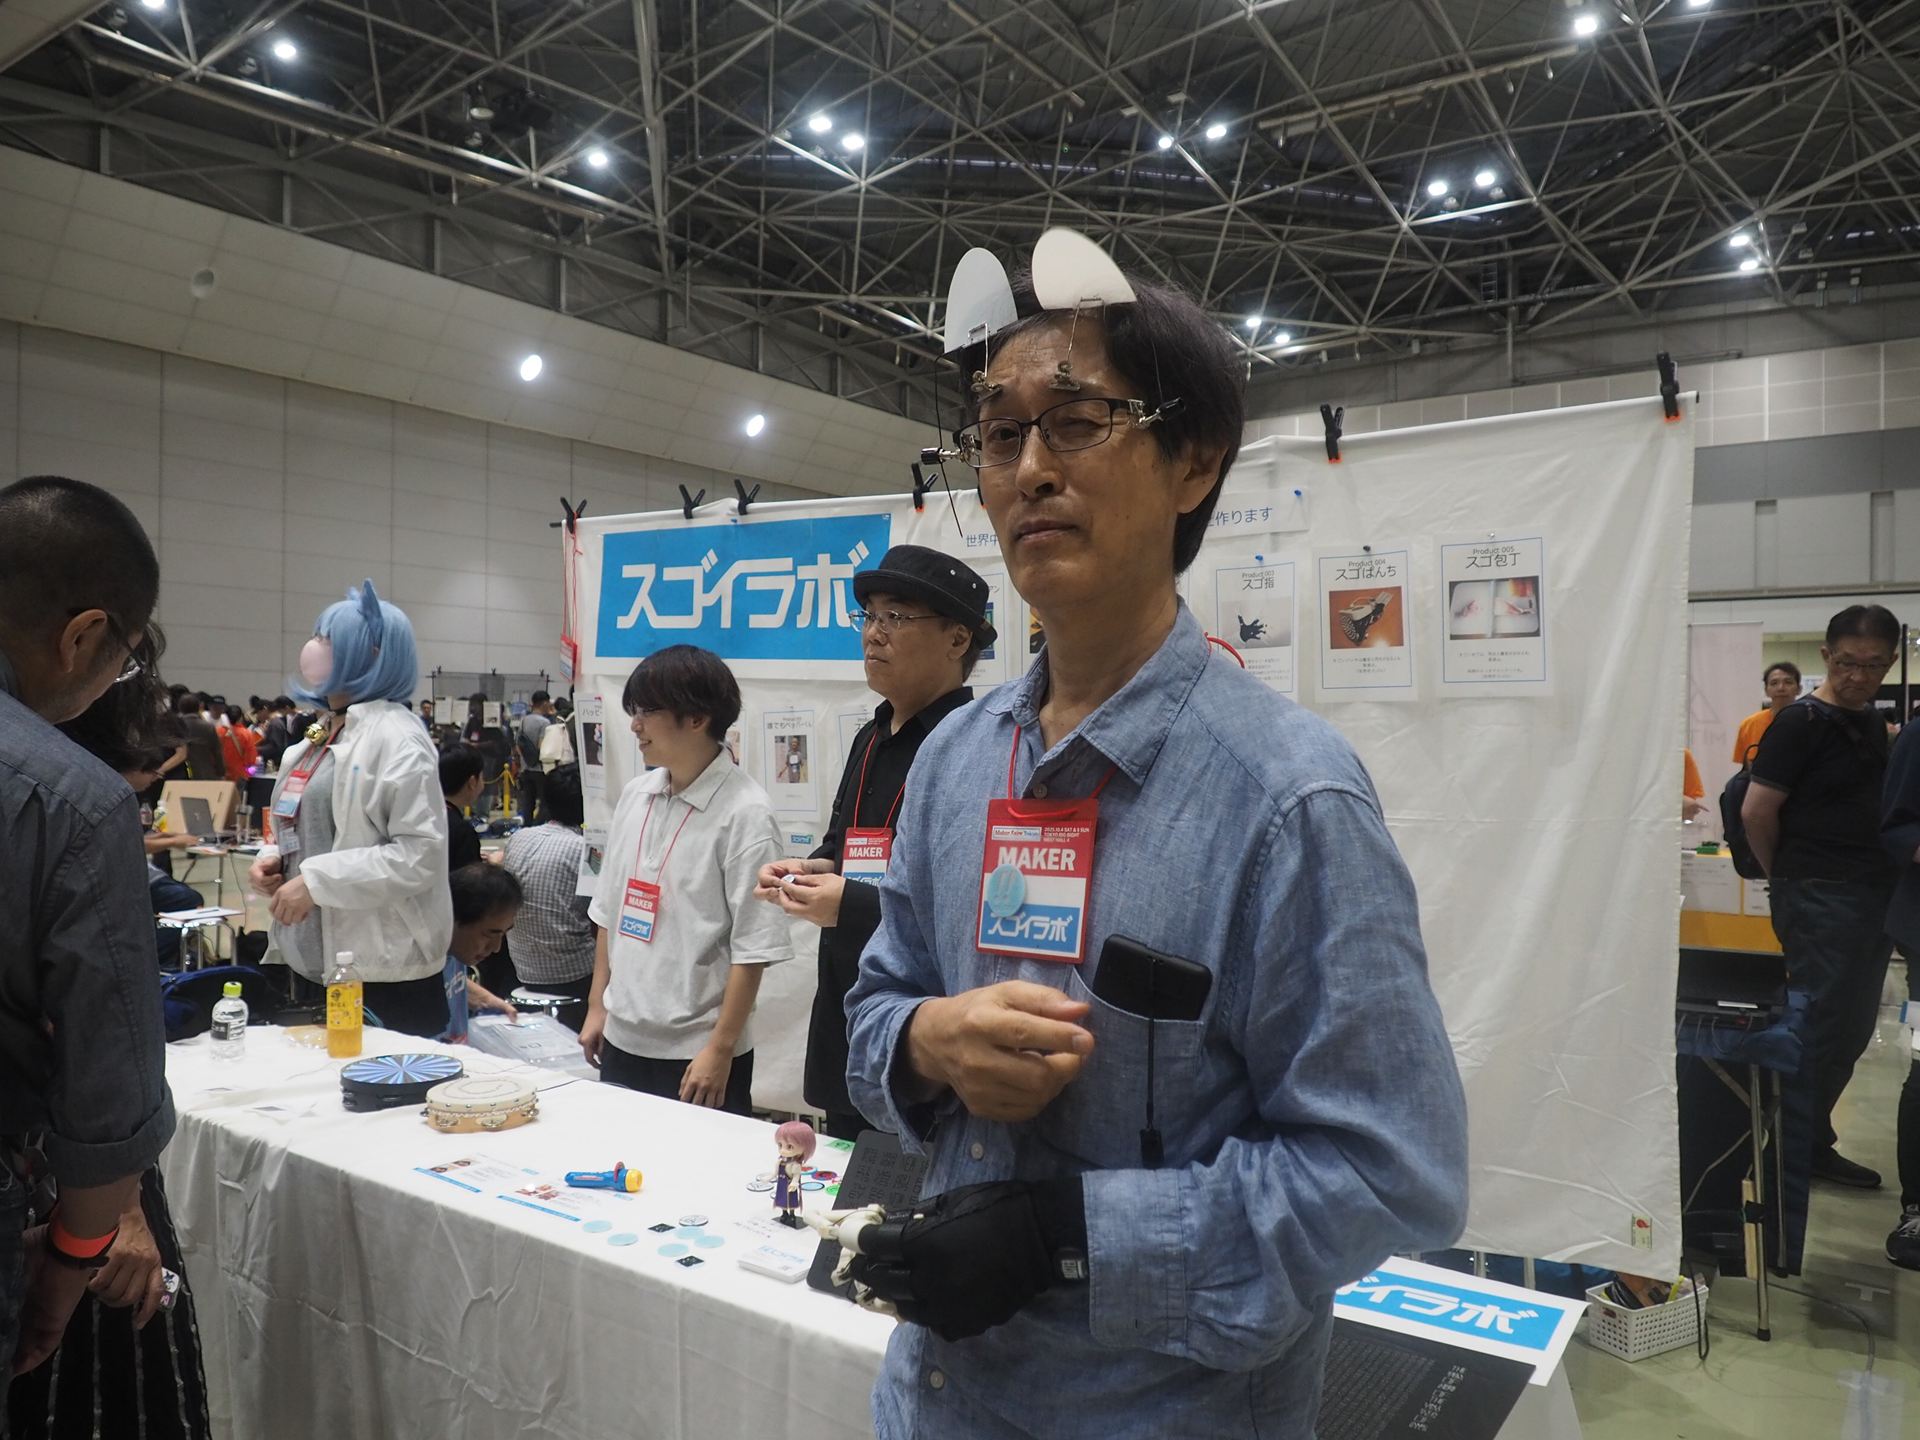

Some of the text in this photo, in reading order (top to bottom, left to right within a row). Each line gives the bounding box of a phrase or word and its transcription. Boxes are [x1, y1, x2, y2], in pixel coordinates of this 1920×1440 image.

[1465, 552, 1521, 569] スゴ包丁
[1335, 565, 1397, 581] スゴぱんち
[616, 540, 870, 629] スゴイラボ
[1242, 577, 1275, 591] スゴ指
[848, 847, 884, 858] MAKER
[998, 847, 1076, 871] MAKER
[628, 895, 654, 912] MAKER
